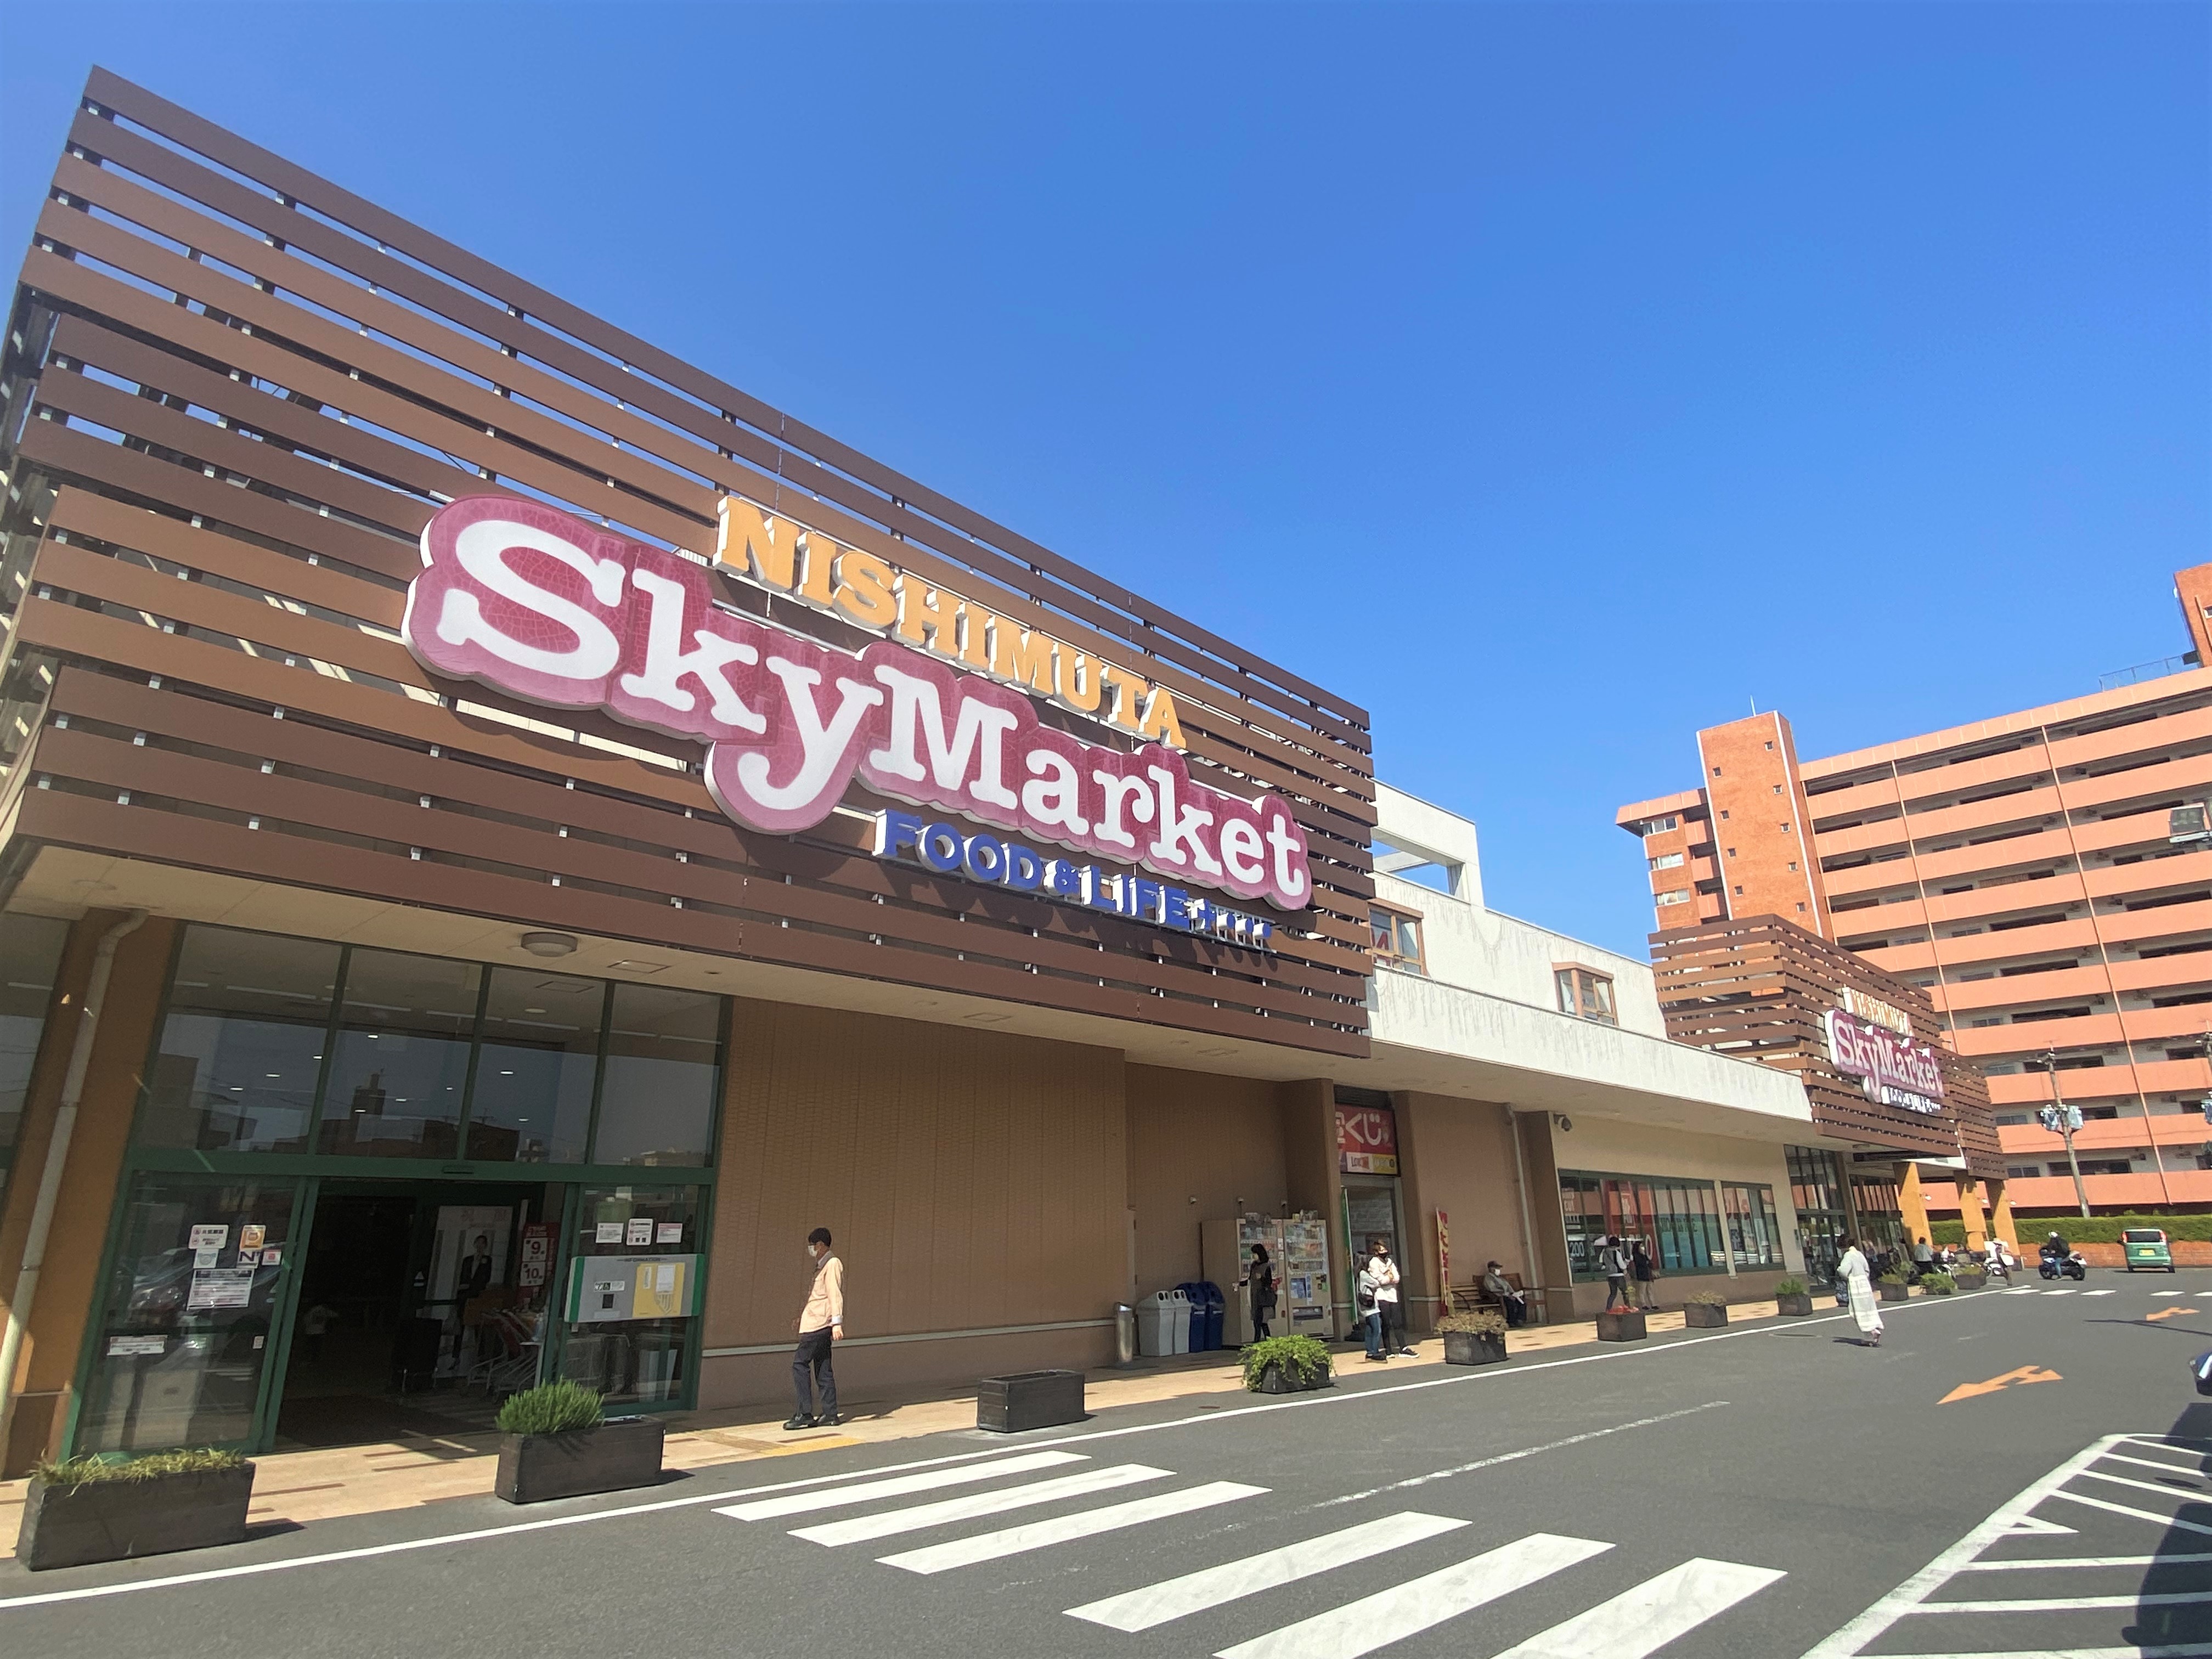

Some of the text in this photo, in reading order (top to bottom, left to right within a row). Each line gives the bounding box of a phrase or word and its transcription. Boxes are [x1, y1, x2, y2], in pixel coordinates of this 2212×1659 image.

[437, 519, 1304, 896] SkyMarket
[712, 495, 1188, 751] NISHIMUTA
[1833, 1018, 1944, 1099] SkyMarket
